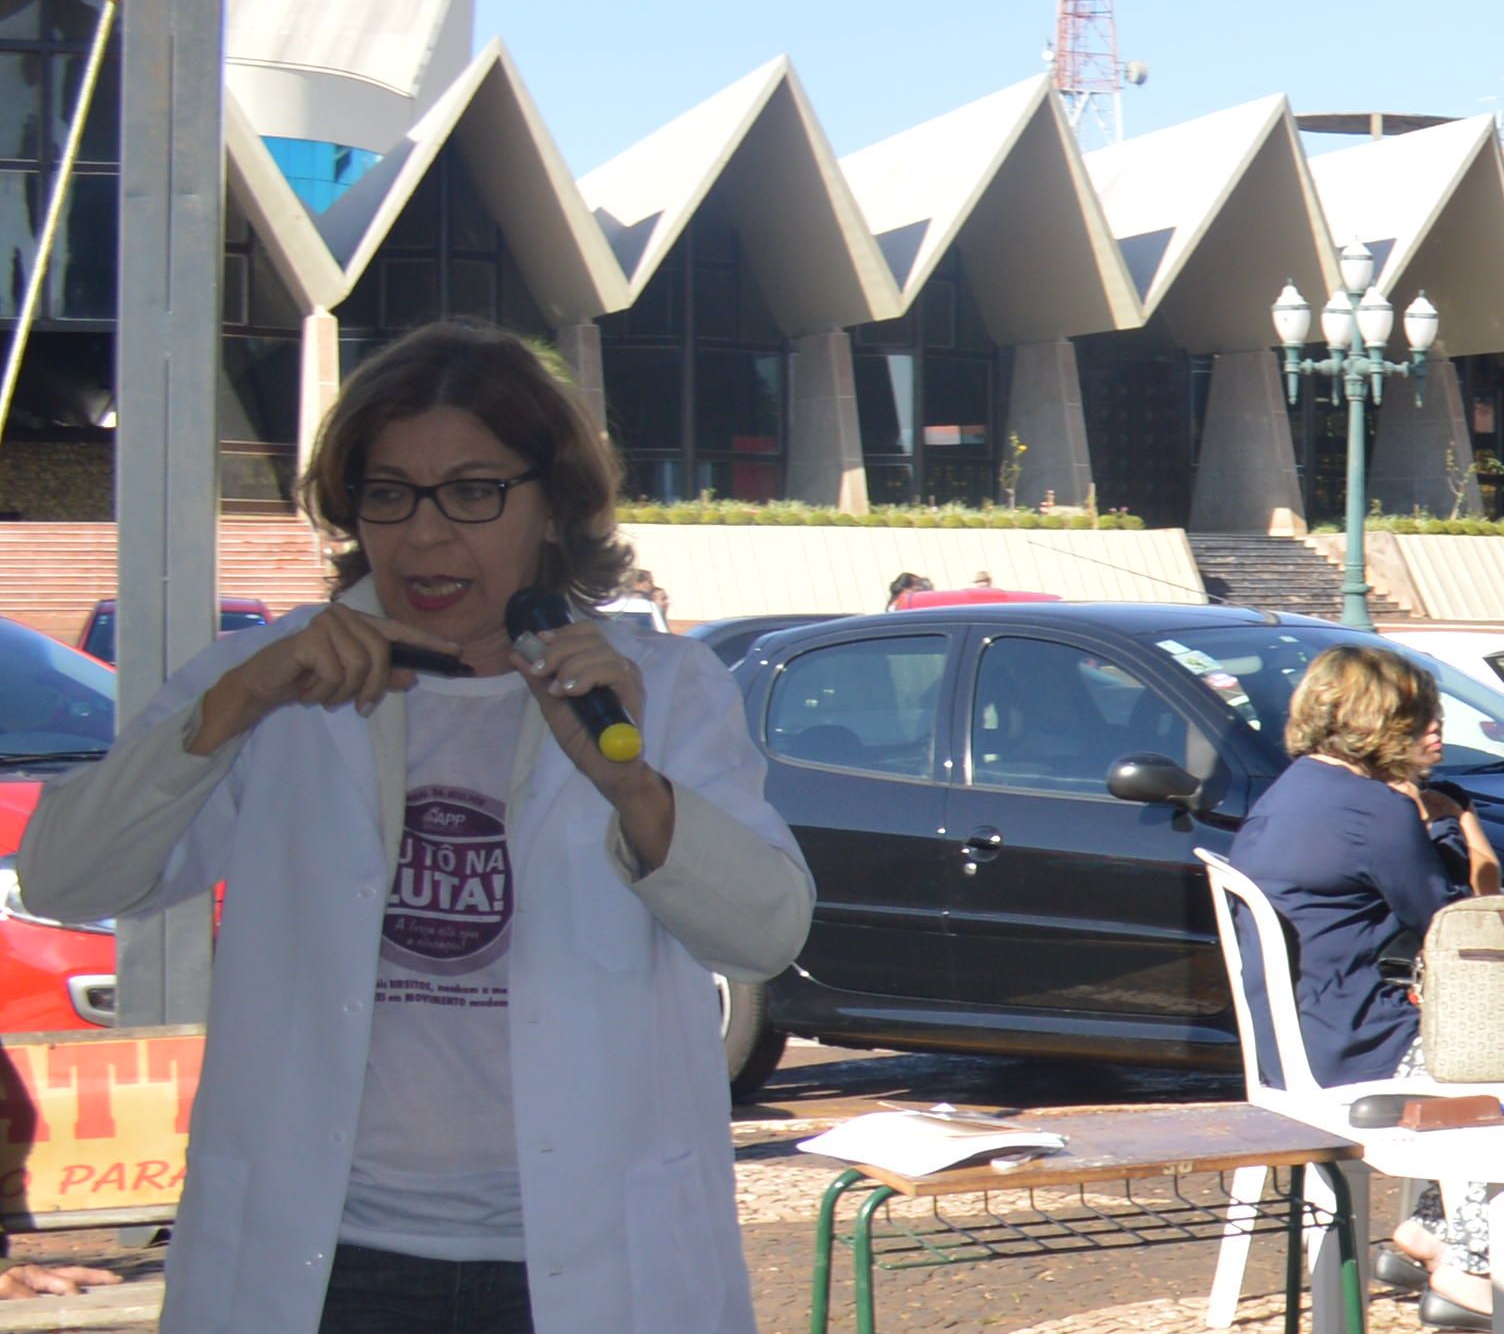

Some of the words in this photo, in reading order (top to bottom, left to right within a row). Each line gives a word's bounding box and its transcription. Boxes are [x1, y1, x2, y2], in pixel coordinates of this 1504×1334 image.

[422, 842, 457, 871] TÔ
[466, 847, 505, 876] NA
[389, 867, 507, 913] UTA!
